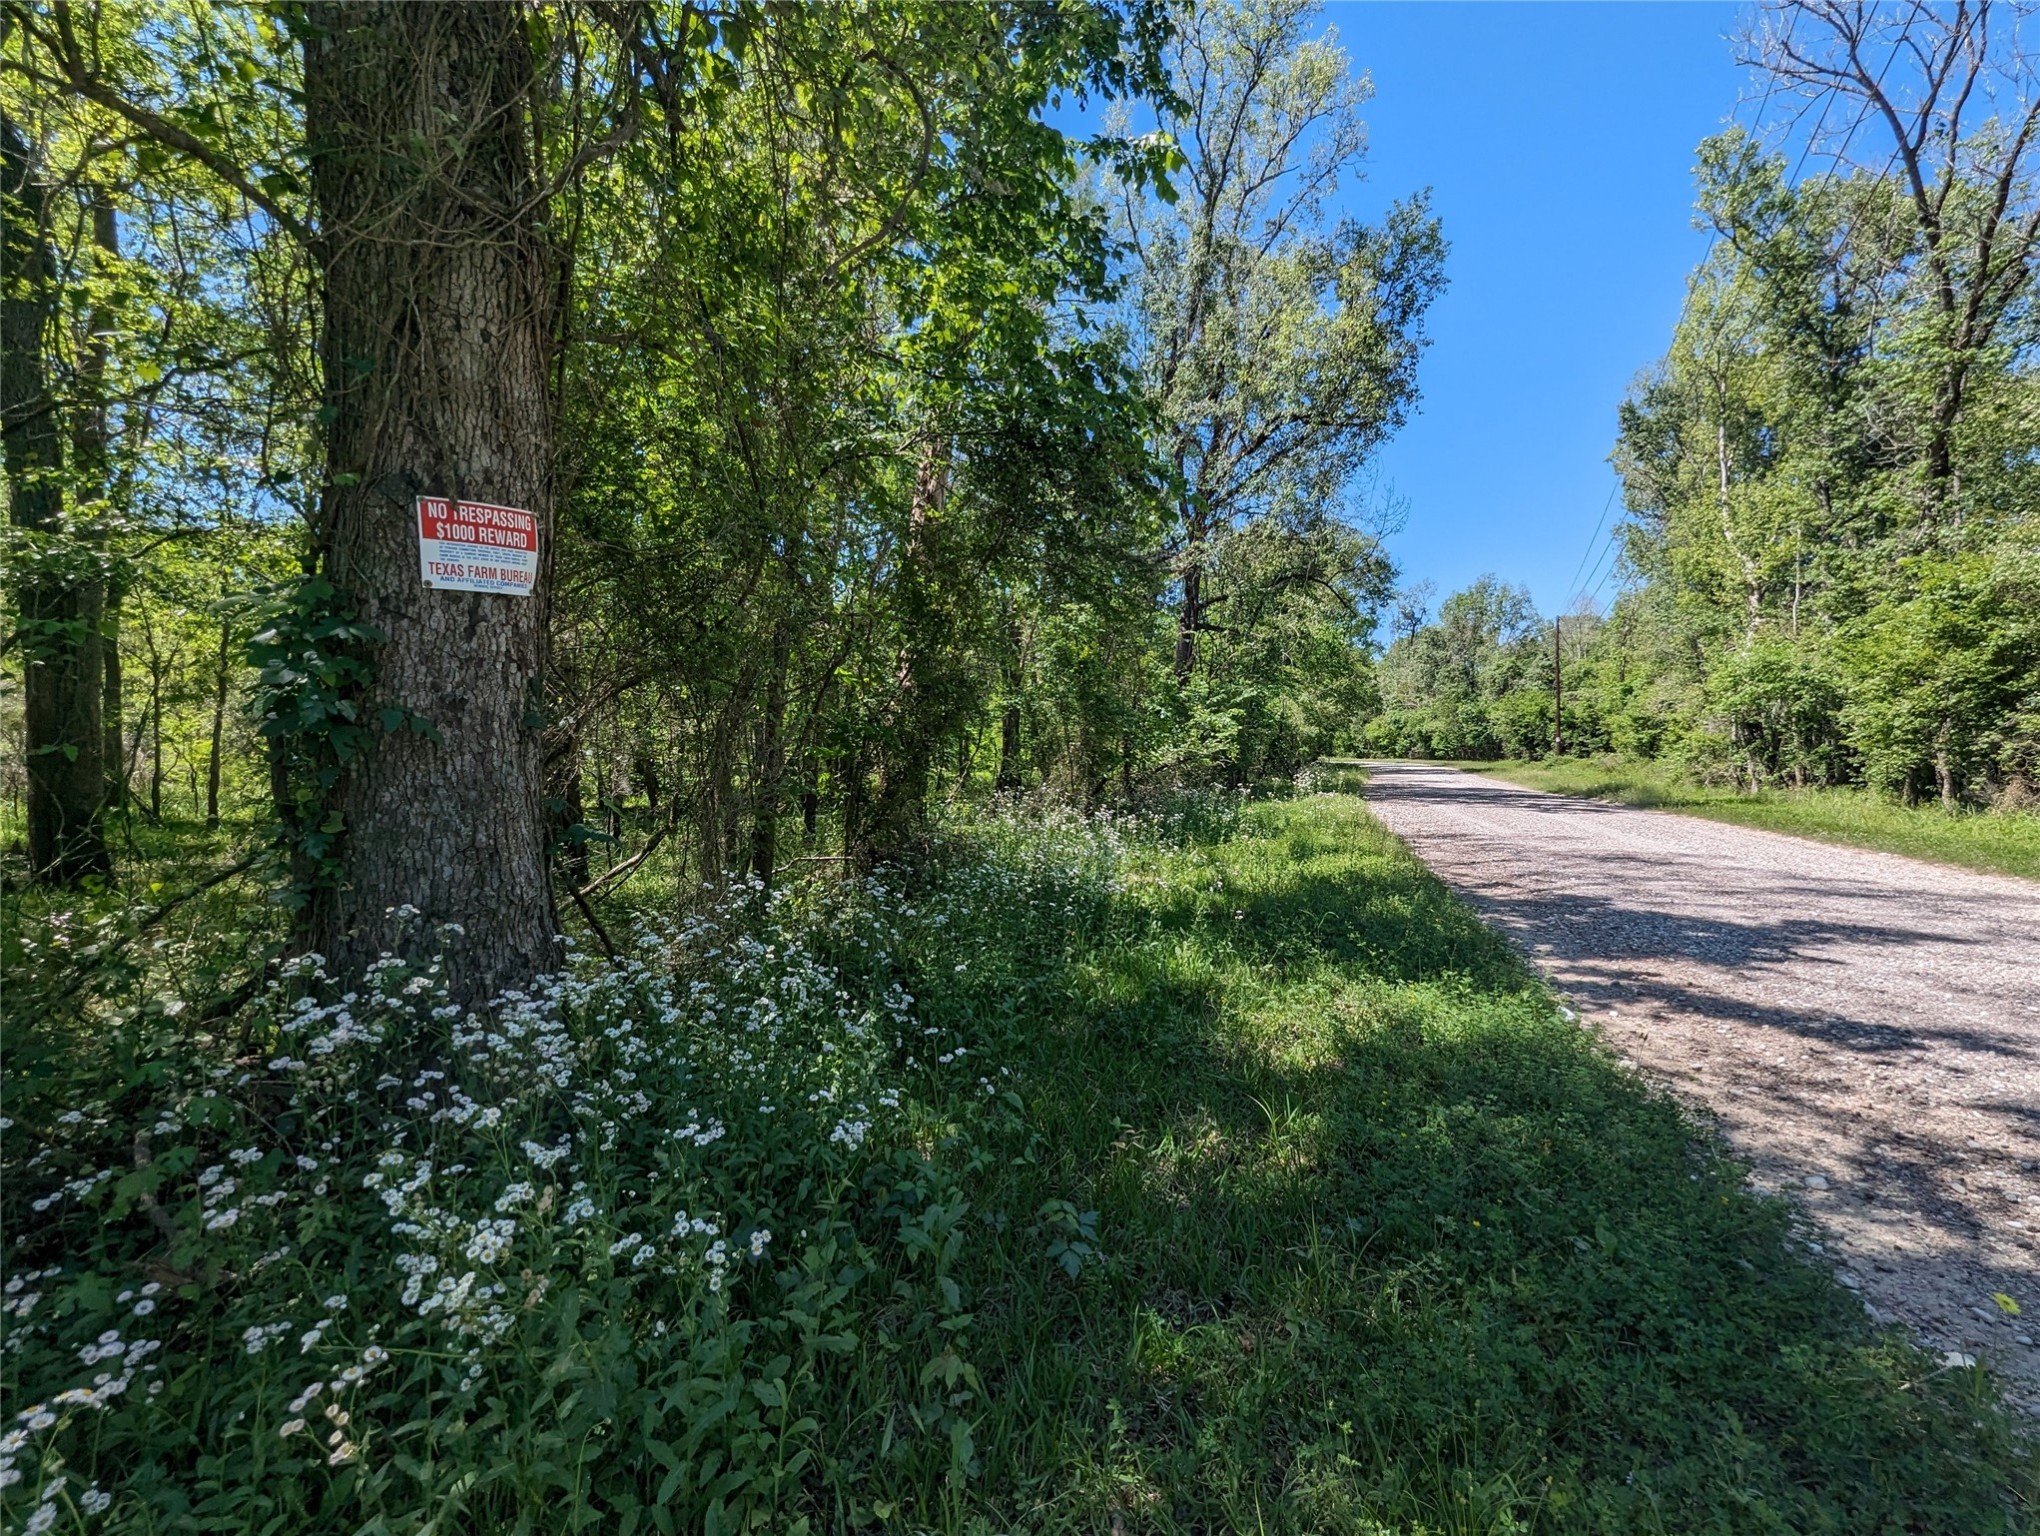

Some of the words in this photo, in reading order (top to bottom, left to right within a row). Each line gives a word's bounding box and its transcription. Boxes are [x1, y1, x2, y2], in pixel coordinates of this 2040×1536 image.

[428, 502, 447, 519] NO
[436, 521, 475, 541] $1000
[479, 527, 527, 548] REWARD
[428, 562, 464, 578] TEXAS
[468, 565, 497, 581] FARM
[501, 569, 532, 584] BUREAU
[457, 577, 494, 586] AFFILIATED
